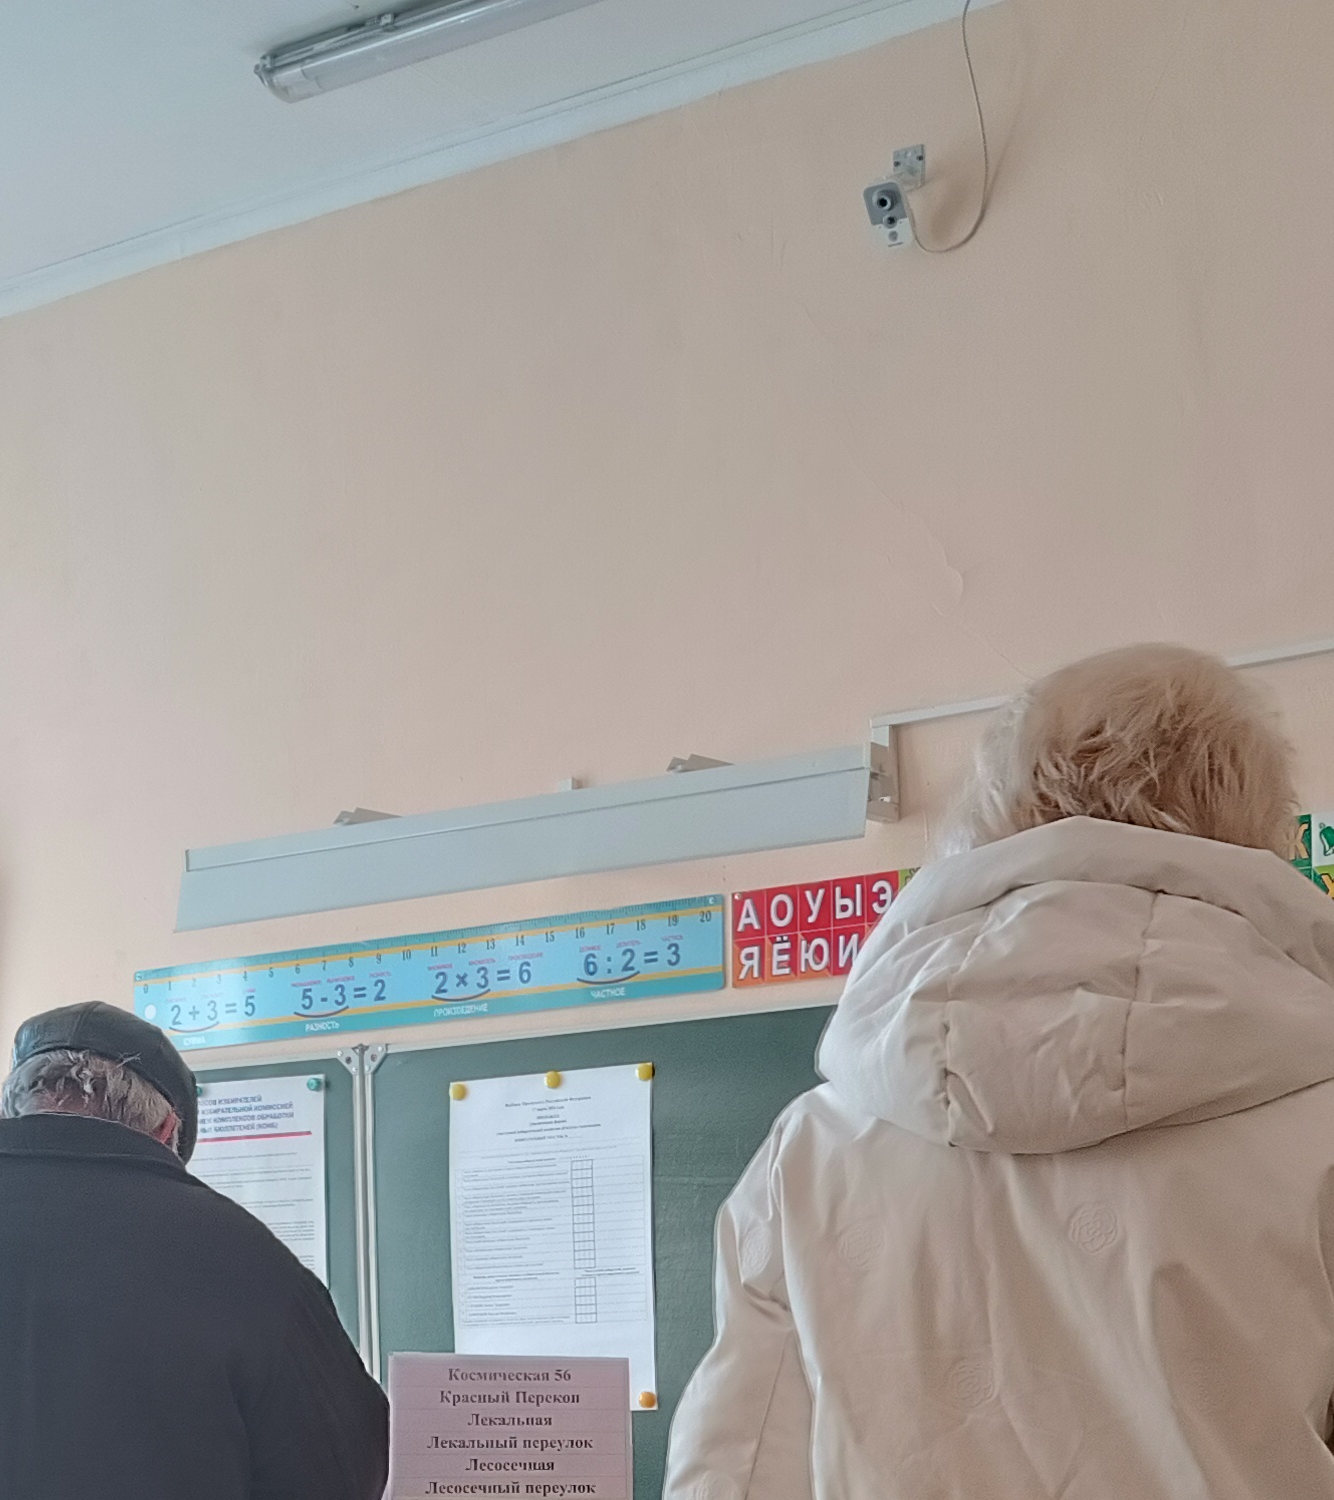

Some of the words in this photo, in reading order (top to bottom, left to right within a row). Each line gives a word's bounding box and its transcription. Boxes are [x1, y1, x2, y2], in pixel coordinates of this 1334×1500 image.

[737, 898, 761, 932] А
[770, 893, 794, 927] О
[805, 888, 826, 923] У
[835, 883, 862, 920] Ы
[871, 880, 893, 915] Э
[143, 984, 149, 994] 0
[168, 981, 172, 991] 1
[242, 970, 248, 981] 4
[269, 967, 274, 978] 5
[295, 964, 300, 974] 6
[322, 960, 327, 971] 7
[348, 957, 354, 968] 8
[376, 953, 382, 964] 9
[402, 949, 412, 961] 10
[431, 946, 439, 957] 11
[457, 943, 467, 954] 12
[486, 939, 496, 950] 13
[515, 935, 525, 946] 14
[545, 931, 555, 943] 15
[575, 927, 585, 939] 16
[606, 923, 615, 935] 17
[636, 919, 646, 931] 18
[668, 915, 679, 927] 19
[699, 910, 712, 923] 20
[583, 953, 598, 976] 6
[621, 948, 635, 972] 2
[667, 943, 681, 967] 3
[739, 946, 761, 980] Я
[771, 936, 792, 976] Ё
[800, 938, 830, 973] Ю
[838, 933, 859, 969] И
[434, 971, 448, 994] 2
[476, 966, 489, 989] 3
[518, 961, 532, 984] 6
[301, 988, 313, 1010] 5
[334, 984, 346, 1007] 3
[373, 979, 386, 1001] 2
[590, 987, 626, 999] ЧАСТНОЕ
[171, 1004, 182, 1025] 2
[206, 1000, 218, 1021] 3
[244, 995, 256, 1017] 5
[448, 1368, 550, 1382] Космическая
[554, 1369, 572, 1382] 56
[439, 1390, 510, 1407] Красный
[467, 1413, 553, 1427] Лекальная
[426, 1436, 518, 1449] Лекальный
[522, 1438, 594, 1452] переулок
[464, 1458, 555, 1472] Лесосечная
[425, 1481, 520, 1495] Лесосечный
[524, 1483, 597, 1497] переулок
